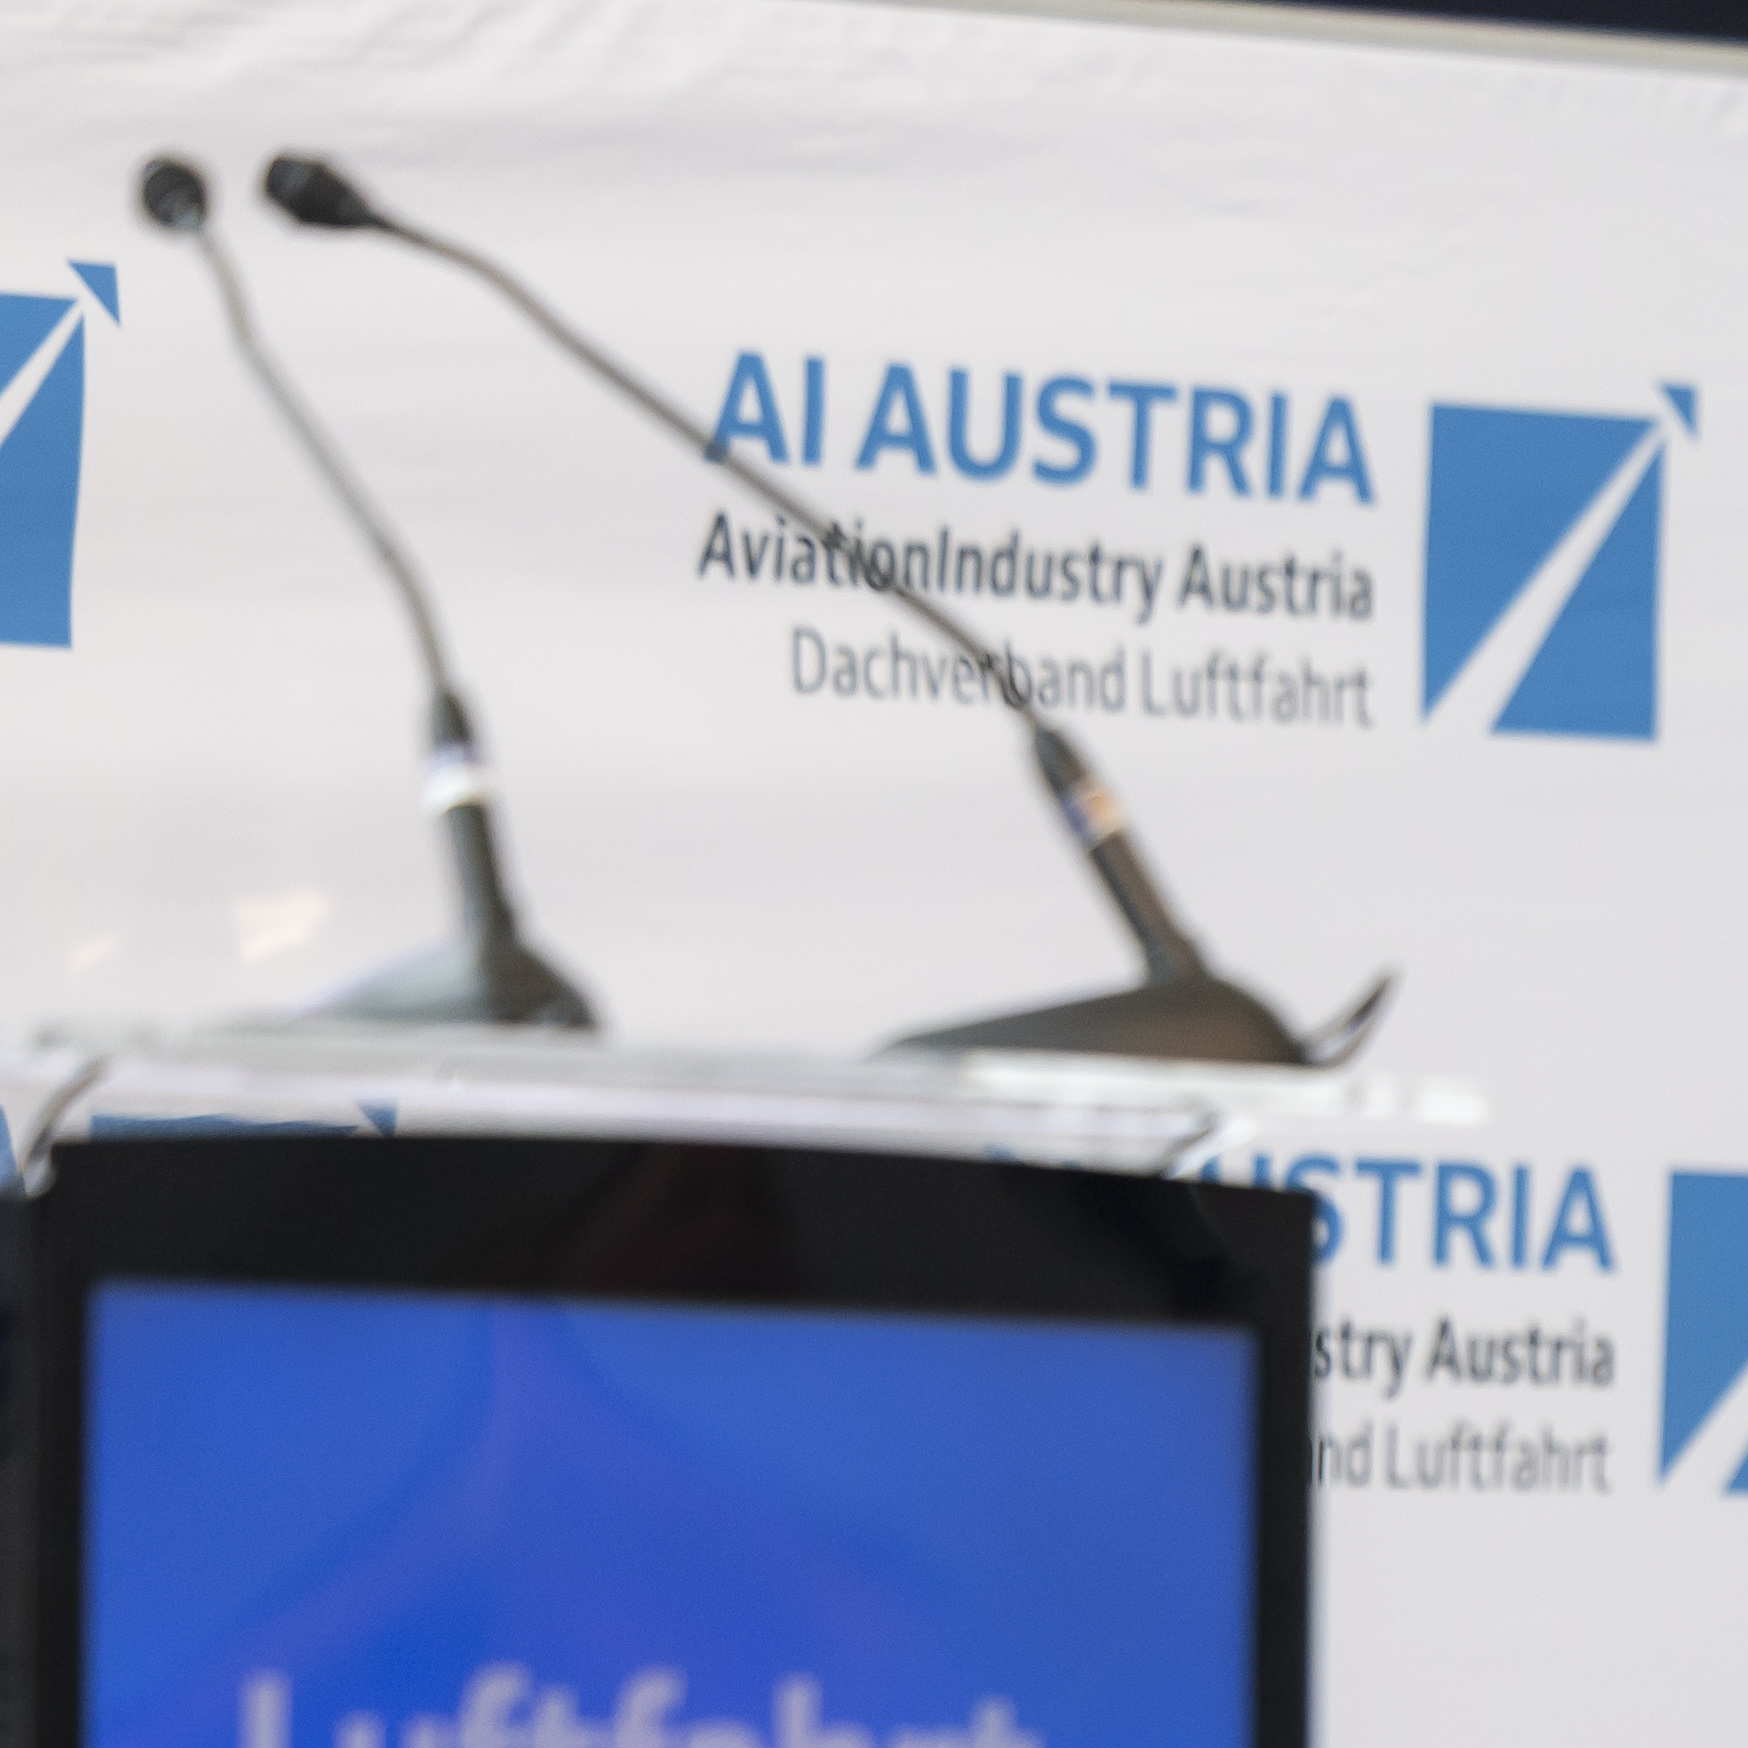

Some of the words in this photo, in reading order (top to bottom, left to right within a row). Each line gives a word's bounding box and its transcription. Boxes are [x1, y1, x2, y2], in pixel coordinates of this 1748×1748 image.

[703, 350, 826, 468] AI
[853, 361, 1377, 507] AUSTRIA
[697, 512, 1162, 626] AviationIndustry
[1175, 541, 1375, 623] Austria
[791, 626, 1127, 716] Dachverband
[1139, 647, 1375, 731] Luftfahrt
[1205, 1150, 1618, 1275] STRIA
[1422, 1314, 1617, 1389] Austria
[1382, 1419, 1612, 1496] Luftfahrt
